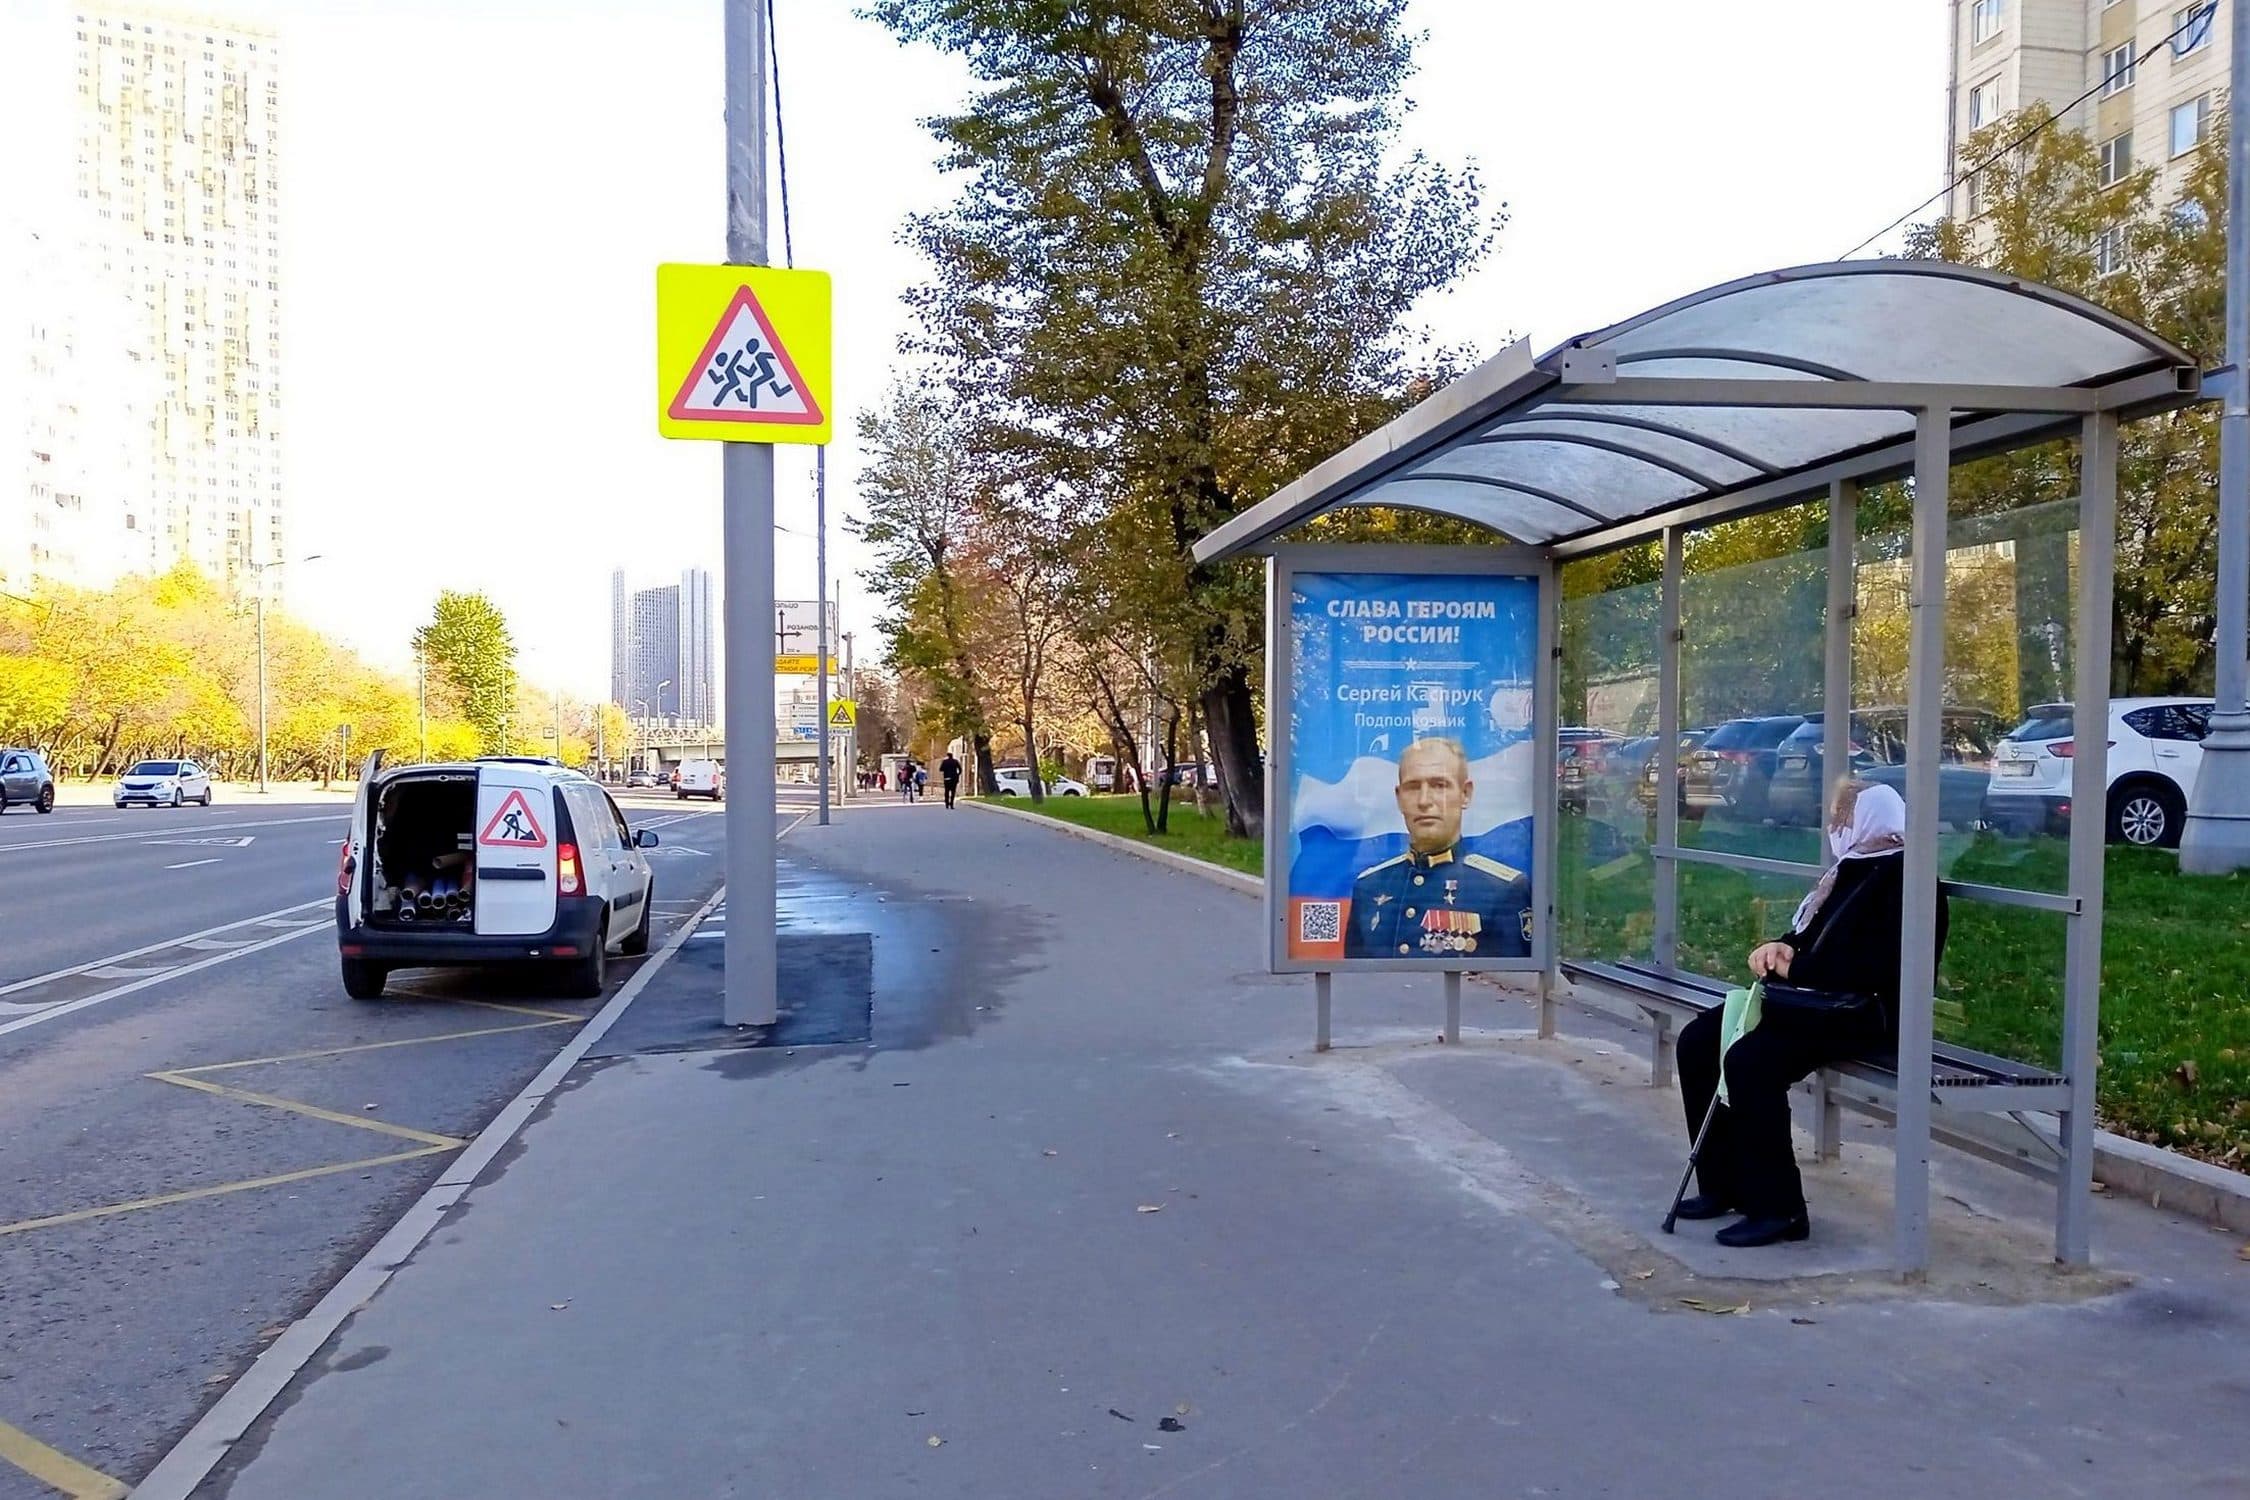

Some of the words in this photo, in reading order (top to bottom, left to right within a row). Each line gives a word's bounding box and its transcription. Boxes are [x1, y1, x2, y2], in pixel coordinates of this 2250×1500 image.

[1327, 600, 1401, 618] СЛАВА
[1407, 600, 1496, 619] ГЕРОЯМ
[1363, 625, 1460, 644] РОССИИ!
[1337, 684, 1401, 705] Сергей
[1407, 685, 1483, 705] Каспрук
[1354, 712, 1466, 729] Подполковник
